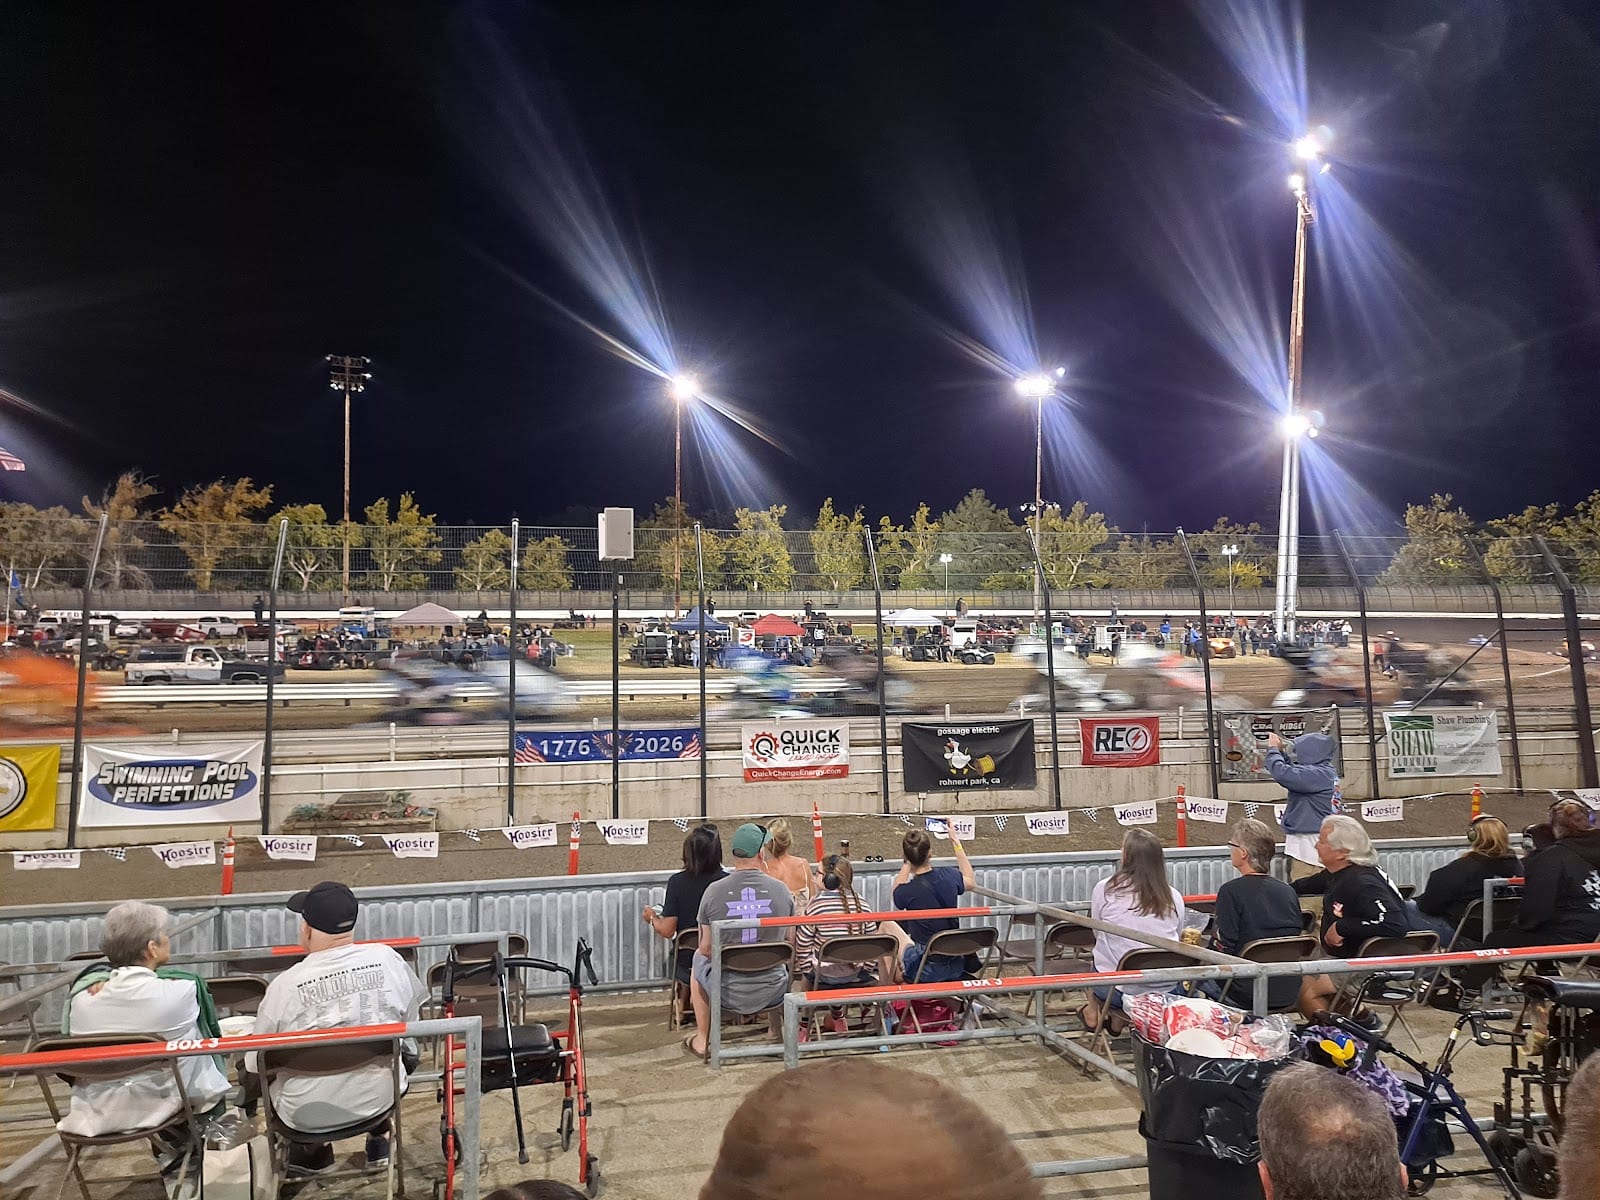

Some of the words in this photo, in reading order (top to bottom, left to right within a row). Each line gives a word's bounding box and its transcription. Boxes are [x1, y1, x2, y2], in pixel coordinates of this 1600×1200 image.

[780, 729, 841, 746] QUICK
[937, 728, 970, 737] gossage
[971, 725, 1000, 734] electric
[539, 739, 591, 757] 1776
[634, 736, 684, 754] 2026
[782, 743, 840, 756] CHANGE
[1391, 730, 1435, 757] SHAW
[97, 762, 195, 785] SWIMMING
[203, 761, 250, 782] POOL
[751, 768, 842, 778] QuickChangeEnergy.com
[939, 777, 969, 787] rohnert
[970, 776, 990, 787] park,
[991, 777, 1001, 785] ca
[112, 783, 236, 804] PERFECTIONS
[165, 1039, 205, 1051] BOX
[206, 1037, 219, 1049] 3
